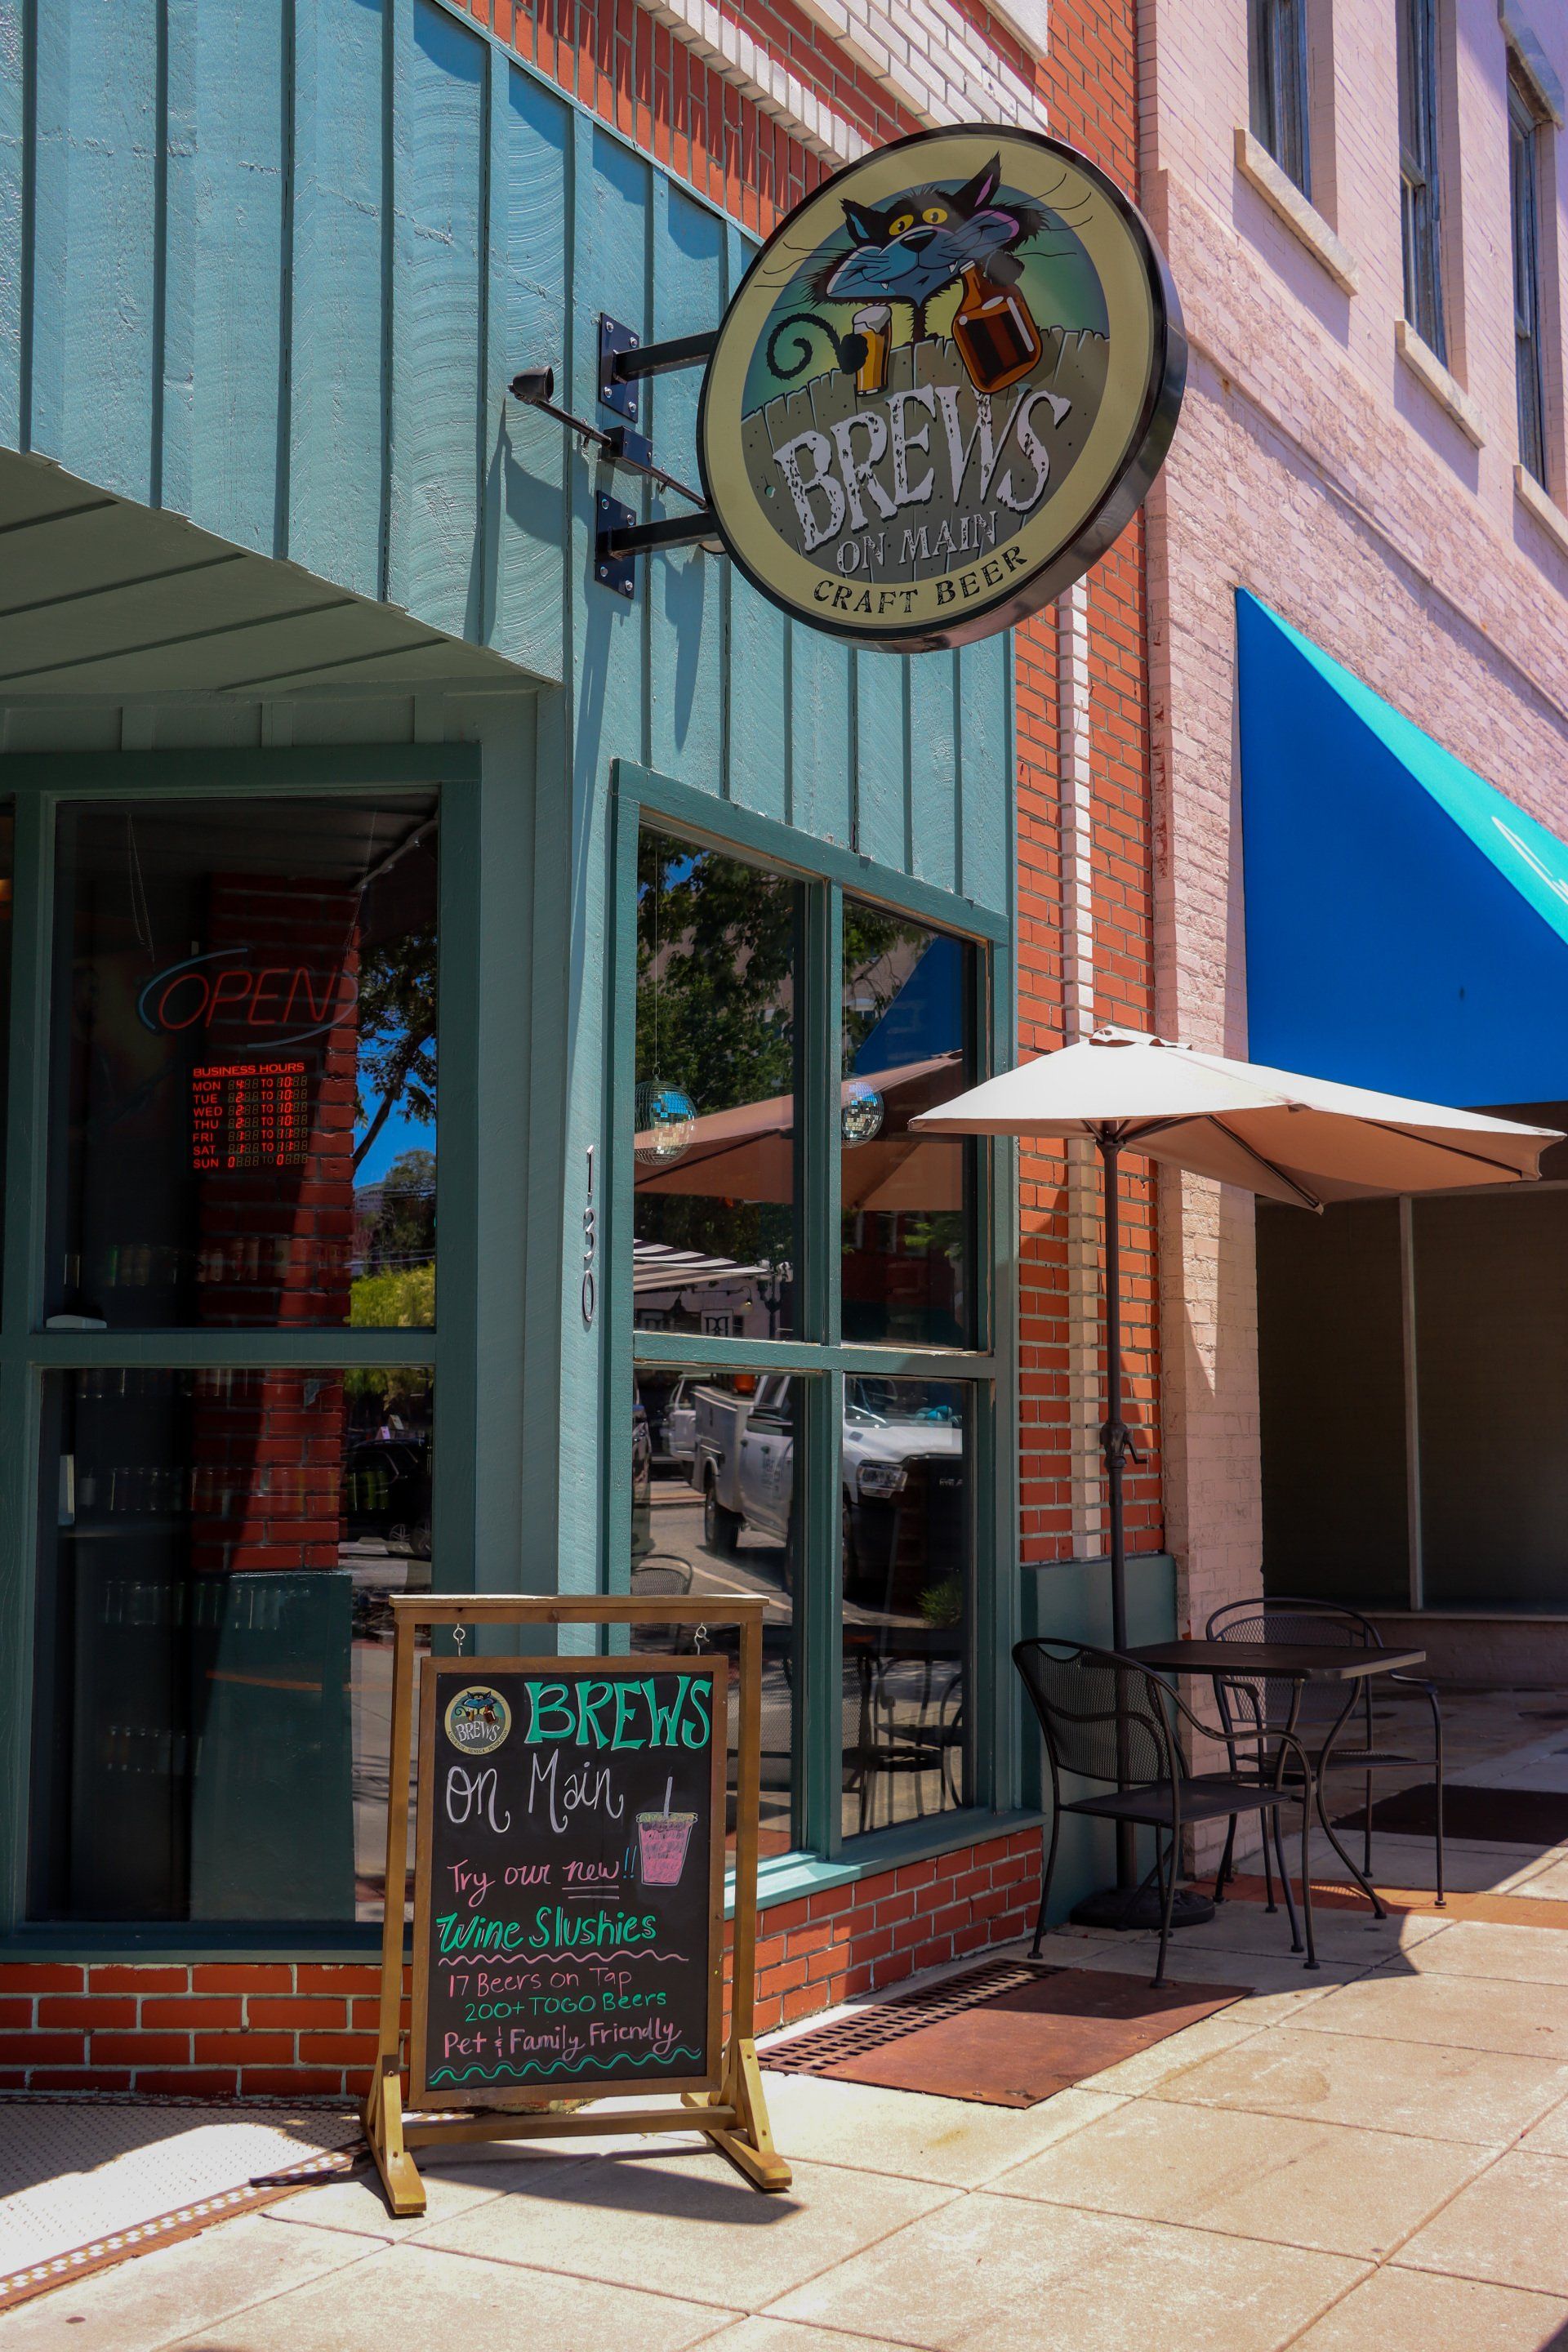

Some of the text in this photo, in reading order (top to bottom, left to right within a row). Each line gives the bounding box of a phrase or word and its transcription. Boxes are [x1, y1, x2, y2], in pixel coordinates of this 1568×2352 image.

[773, 383, 1071, 551] BREWS
[836, 510, 999, 573] ON MAIN
[813, 546, 1027, 613] CRAFT BEER
[158, 965, 337, 1030] OPEN
[193, 1063, 305, 1076] BUSINESS HOURS
[193, 1081, 220, 1091] MON
[261, 1079, 273, 1087] TO
[194, 1094, 217, 1104] TUE
[261, 1091, 273, 1100] TO
[194, 1107, 222, 1116] WED
[261, 1104, 273, 1113] TO
[193, 1133, 213, 1143] FRI
[261, 1129, 274, 1138] TO
[194, 1120, 219, 1129] THU
[261, 1116, 274, 1125] TO
[194, 1145, 216, 1155] SAT
[261, 1143, 274, 1152] TO
[194, 1158, 219, 1168] SUN
[523, 1675, 713, 1751] BREWS
[455, 1721, 500, 1742] BREWS
[446, 1748, 624, 1833] On Main
[447, 1859, 496, 1908] Try
[504, 1863, 552, 1886] our
[435, 1906, 657, 1953] Wine Slushies
[448, 1967, 632, 1998] 17 Beers on Tap
[464, 1992, 667, 2023] 200+ TOGO Beers
[444, 2031, 488, 2058] Pet
[510, 2025, 586, 2061] Family
[589, 2016, 683, 2055] Friendly
